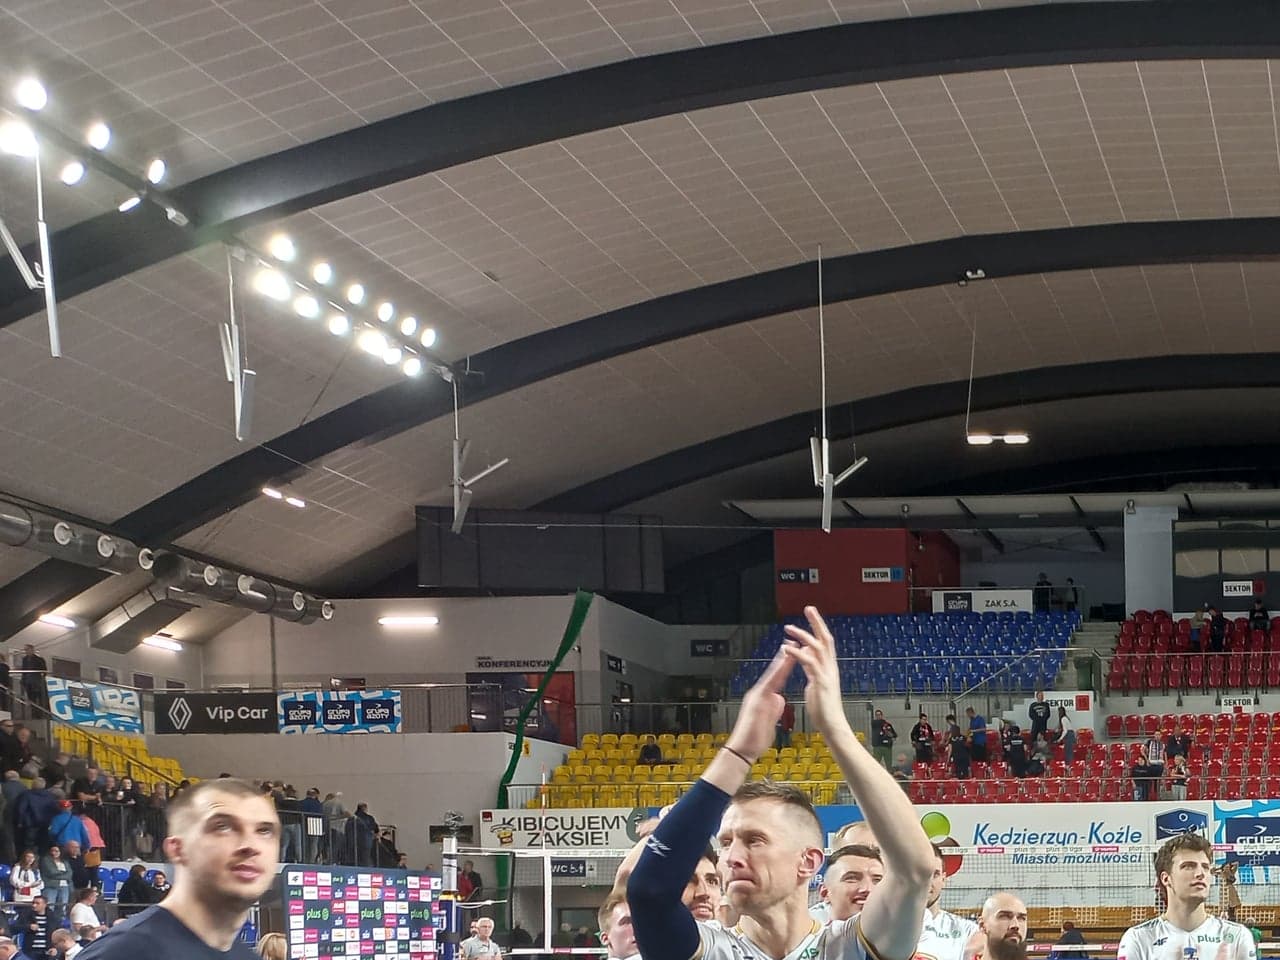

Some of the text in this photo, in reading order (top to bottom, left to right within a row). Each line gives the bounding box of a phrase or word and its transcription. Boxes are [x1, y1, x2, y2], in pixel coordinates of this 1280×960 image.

[781, 572, 795, 580] WC
[863, 571, 889, 579] SEKTOR
[206, 706, 268, 724] Vip Car
[527, 831, 610, 847] ZAKSIE!
[1012, 853, 1058, 864] Miasto
[552, 864, 568, 873] WC
[306, 908, 322, 920] plus
[361, 908, 375, 920] plus
[1197, 935, 1221, 944] plus
